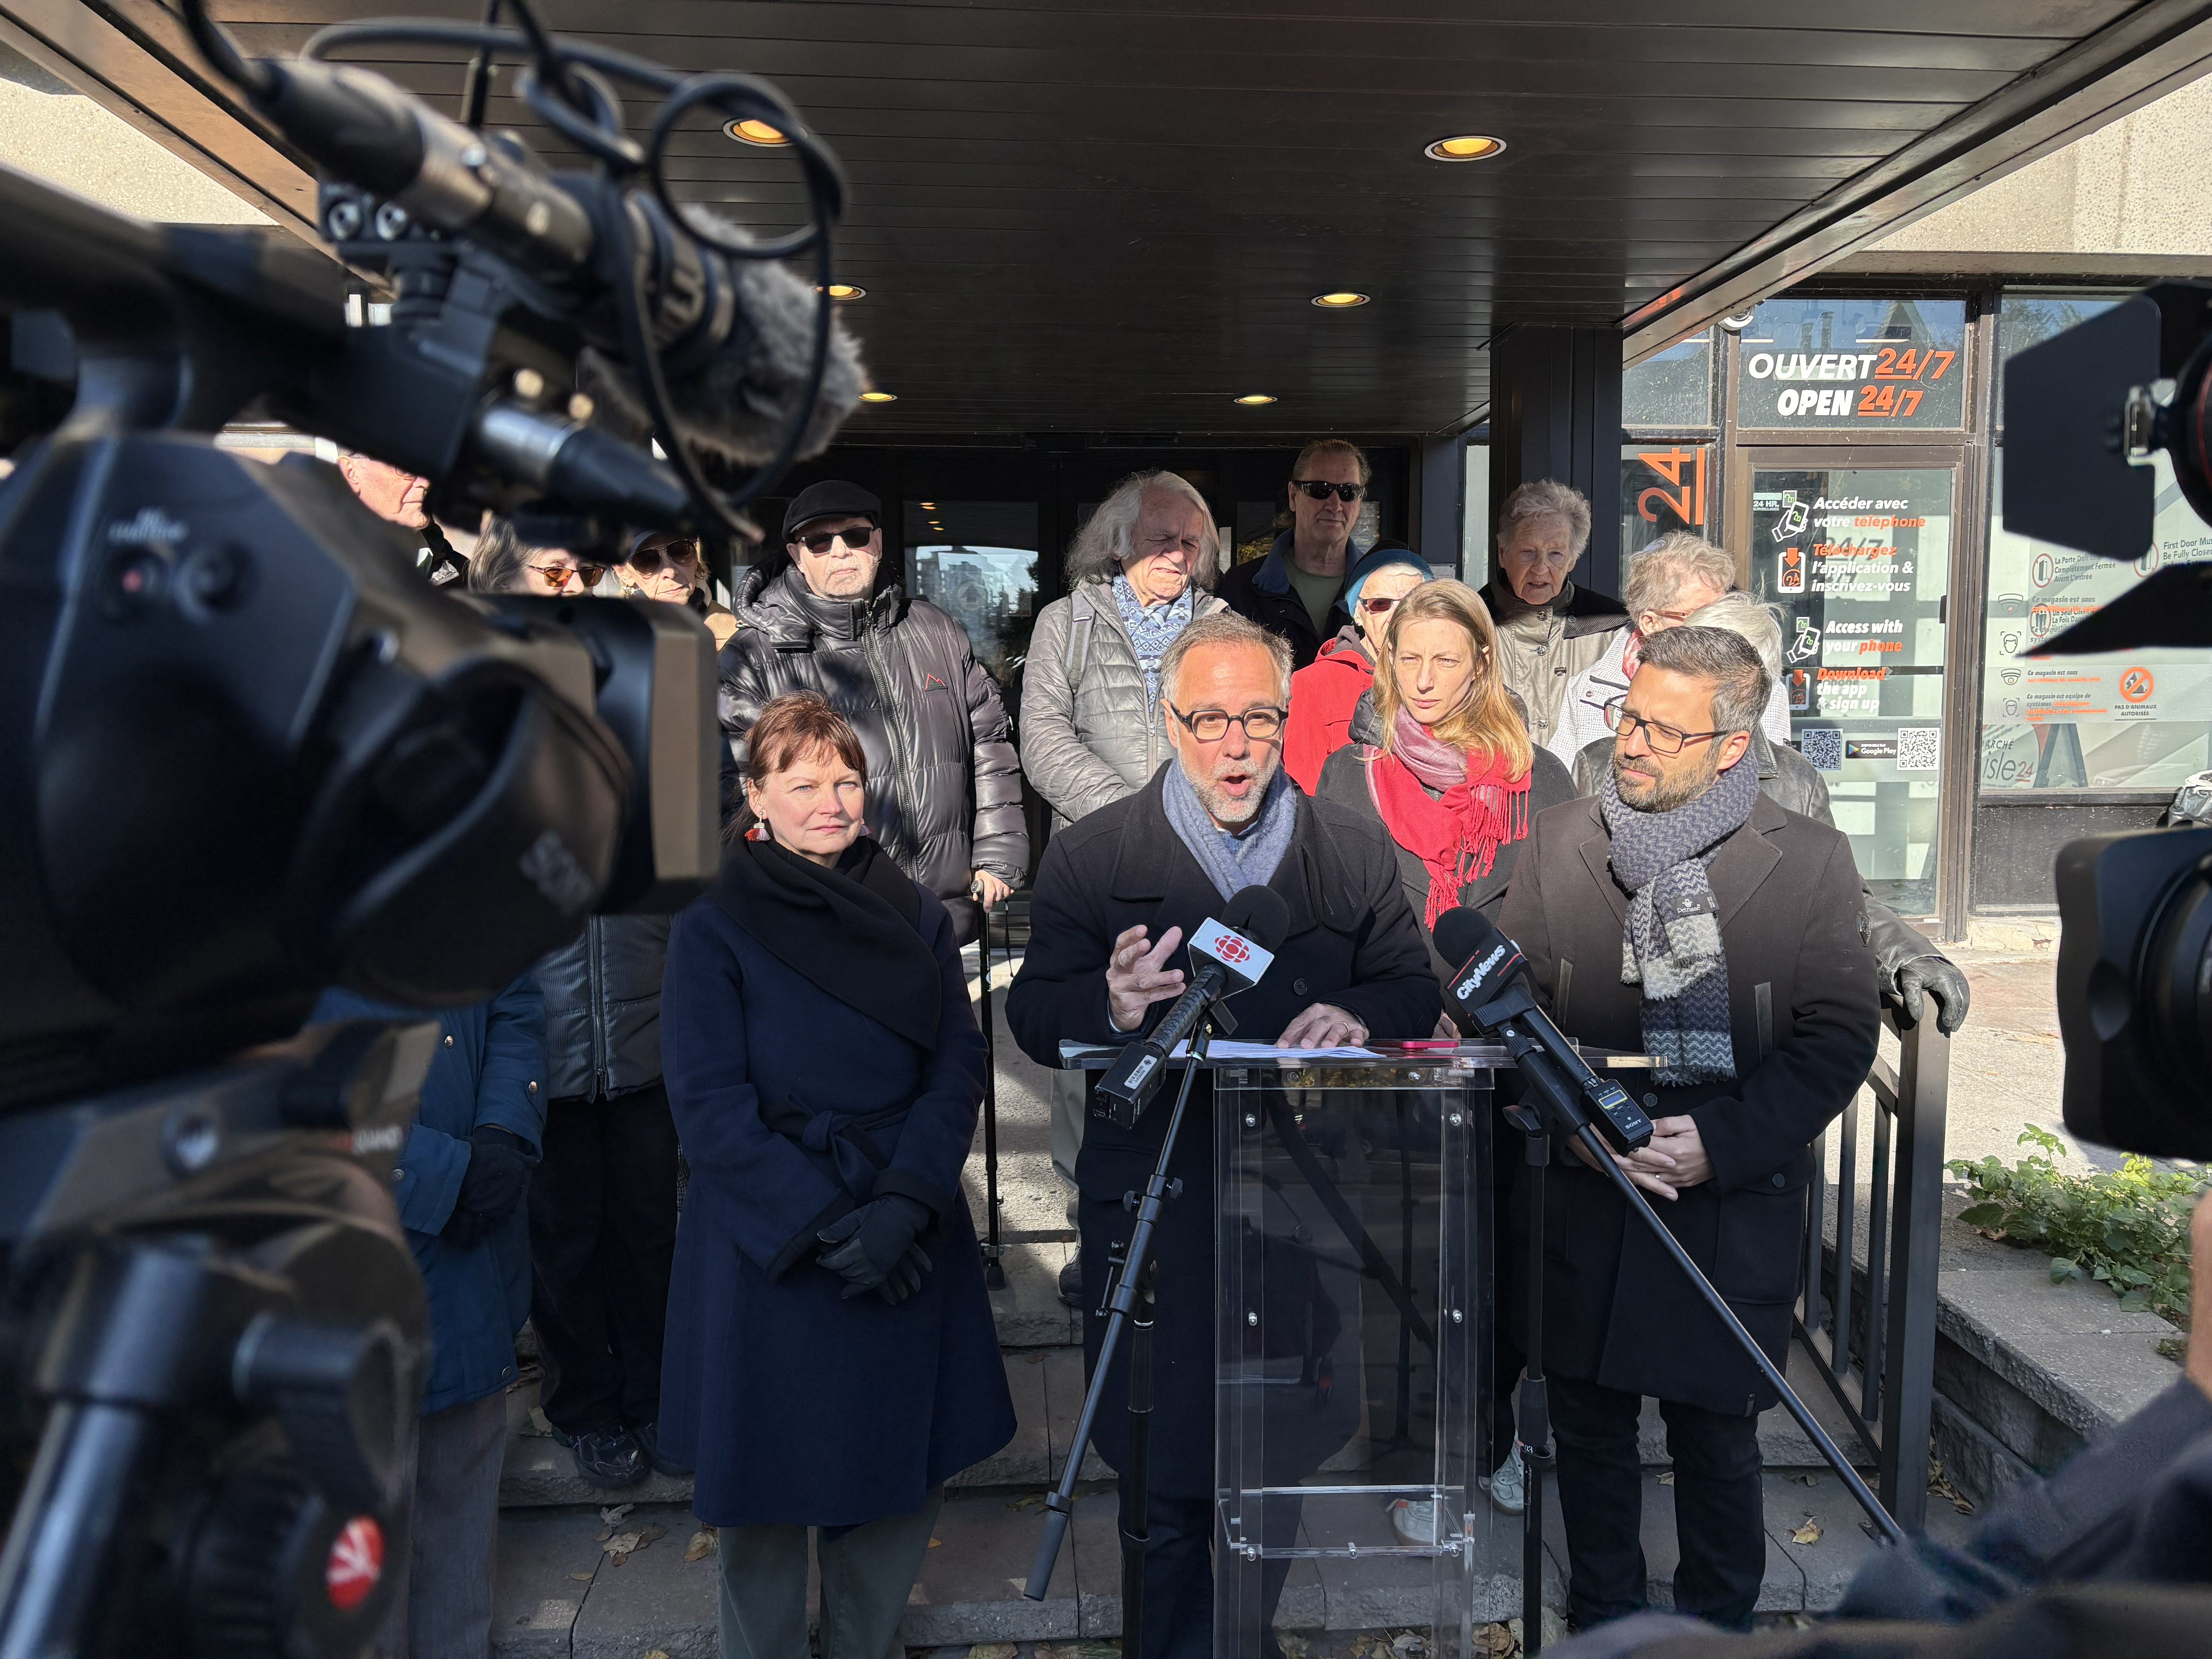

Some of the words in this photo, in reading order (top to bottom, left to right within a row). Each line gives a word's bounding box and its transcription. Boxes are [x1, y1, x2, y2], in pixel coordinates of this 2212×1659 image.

[1748, 353, 1877, 380] OUVERT
[1875, 348, 1955, 380] 24/7
[1777, 389, 1854, 416] OPEN
[1858, 385, 1923, 417] 24/7
[1638, 447, 1692, 525] 24
[1813, 496, 1871, 510] Accéder
[1873, 499, 1909, 510] avec
[1814, 517, 1851, 527] votre
[1854, 515, 1926, 530] téléphone
[1813, 543, 1897, 559] Téléchargez
[2164, 541, 2178, 550] First
[2181, 540, 2197, 548] Door
[2173, 550, 2190, 560] Fully
[1811, 561, 1899, 579] l'application
[1901, 562, 1914, 574] &
[2095, 562, 2116, 570] Fermée
[1811, 579, 1911, 592] inscrivez-vous
[2041, 596, 2068, 604] magasin
[1825, 620, 1869, 634] Access
[1871, 619, 1903, 634] with
[1824, 641, 1859, 656] your
[1858, 639, 1903, 655] phone
[1817, 667, 1887, 680] Download
[1817, 683, 1840, 696] the
[1841, 685, 1867, 699] app
[1817, 697, 1829, 709] &
[1829, 697, 1859, 713] sign
[1862, 699, 1879, 713] up
[1861, 747, 1883, 756] Google
[1457, 945, 1506, 1000] CityNews
[1625, 1119, 1641, 1129] SONY
